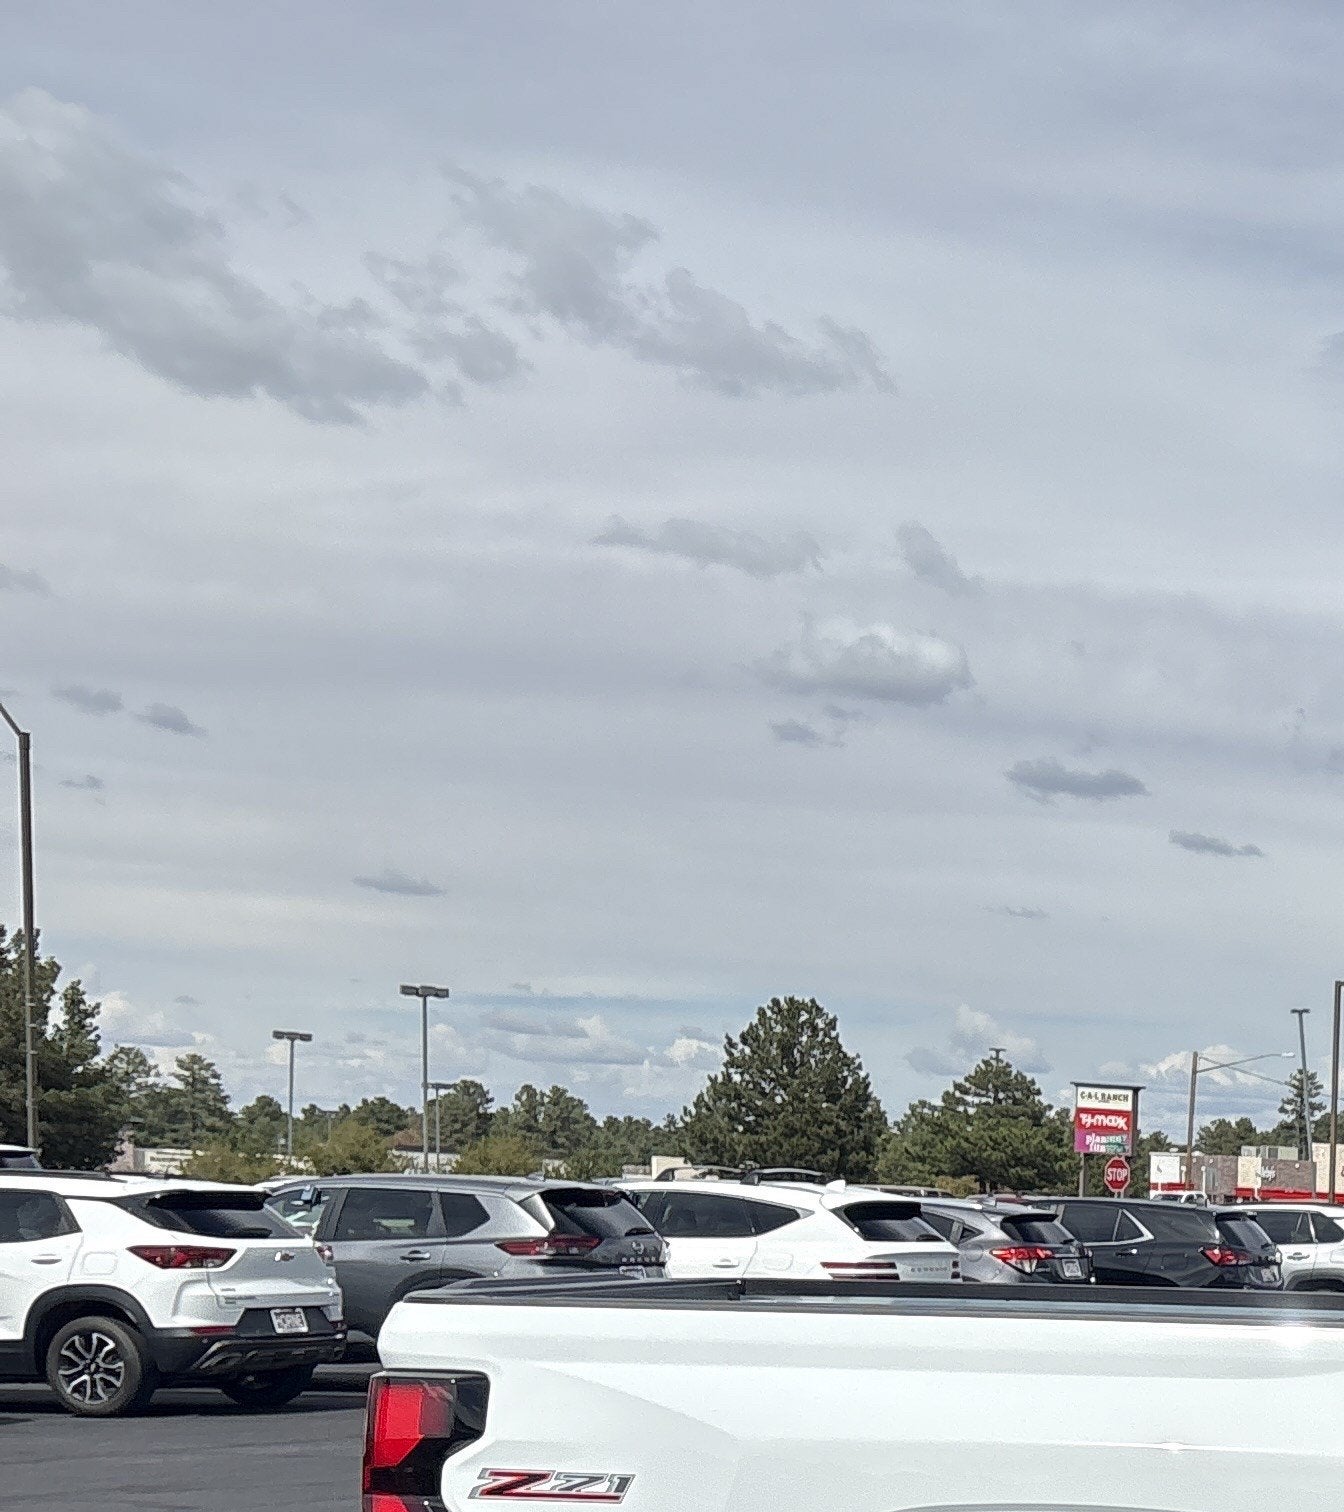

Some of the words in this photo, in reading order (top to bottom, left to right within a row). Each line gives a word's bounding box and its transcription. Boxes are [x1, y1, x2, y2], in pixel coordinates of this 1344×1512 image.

[1101, 1092, 1129, 1102] RANCH
[1106, 1167, 1127, 1181] STOP
[467, 1467, 637, 1504] Z71
